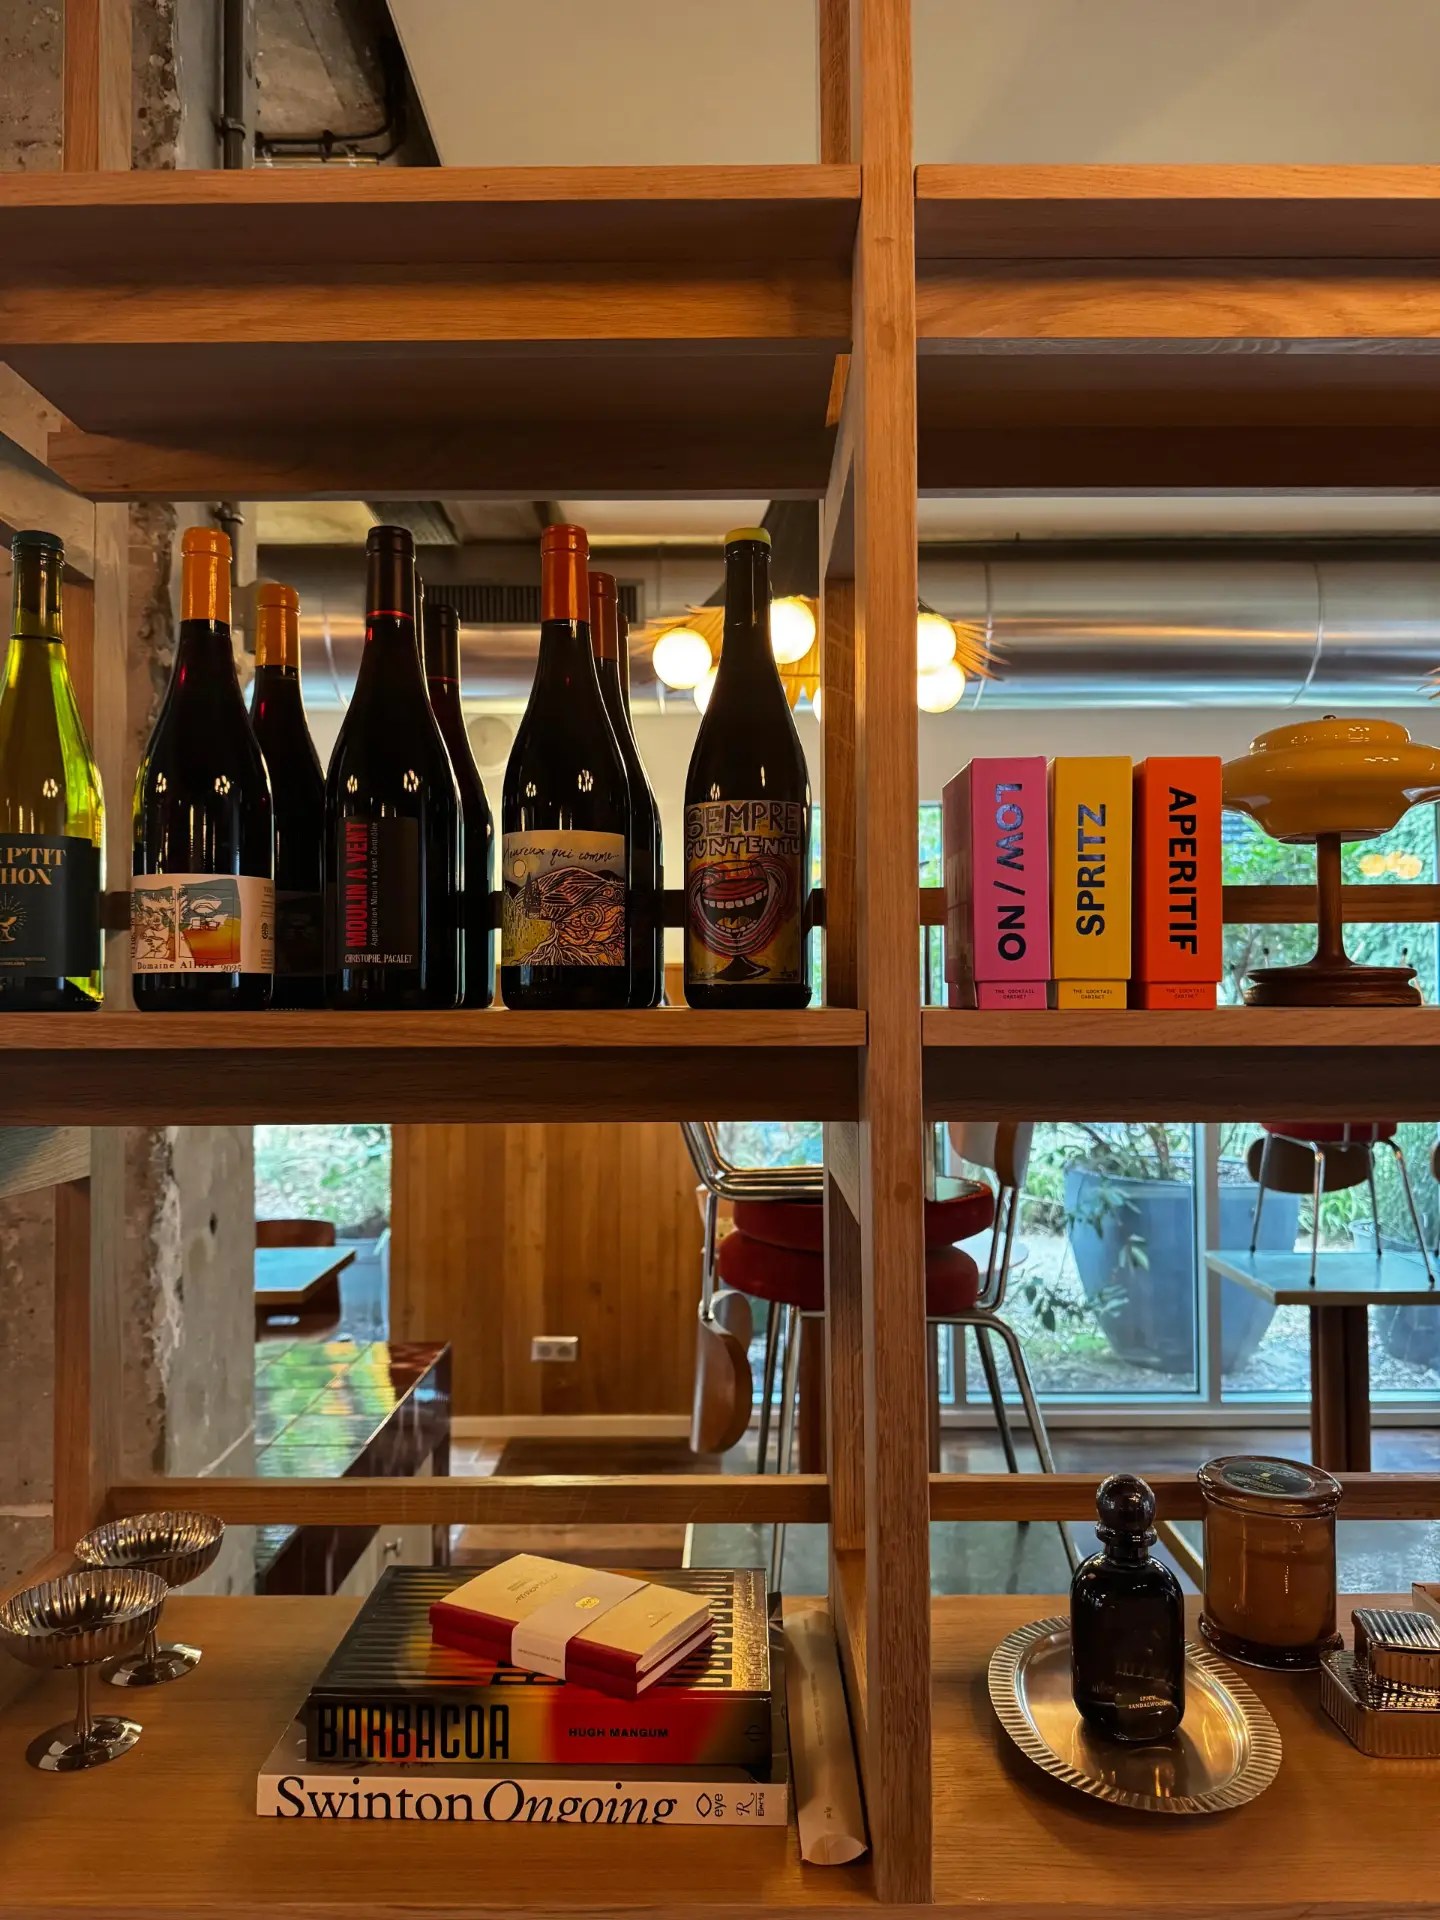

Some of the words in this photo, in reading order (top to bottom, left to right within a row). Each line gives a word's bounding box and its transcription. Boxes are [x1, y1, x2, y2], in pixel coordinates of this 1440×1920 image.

[686, 801, 800, 839] SEMPRE
[994, 783, 1024, 871] LOW
[345, 822, 368, 863] VENT
[551, 848, 574, 866] qui
[345, 868, 368, 880] A
[993, 880, 1026, 896] /
[1076, 803, 1106, 936] SPRITZ
[1168, 786, 1198, 955] APERITIF
[344, 884, 368, 947] MOULIN
[996, 905, 1027, 961] NO
[137, 961, 175, 970] Domaine
[344, 954, 381, 964] CHRISTOPHE
[383, 954, 413, 964] PACALET
[318, 1704, 509, 1759] BARBACOA
[568, 1728, 606, 1738] HUGH
[609, 1728, 669, 1738] MANGUM
[277, 1776, 473, 1821] Swinton
[483, 1780, 677, 1824] Ongoing
[714, 1793, 727, 1817] eye
